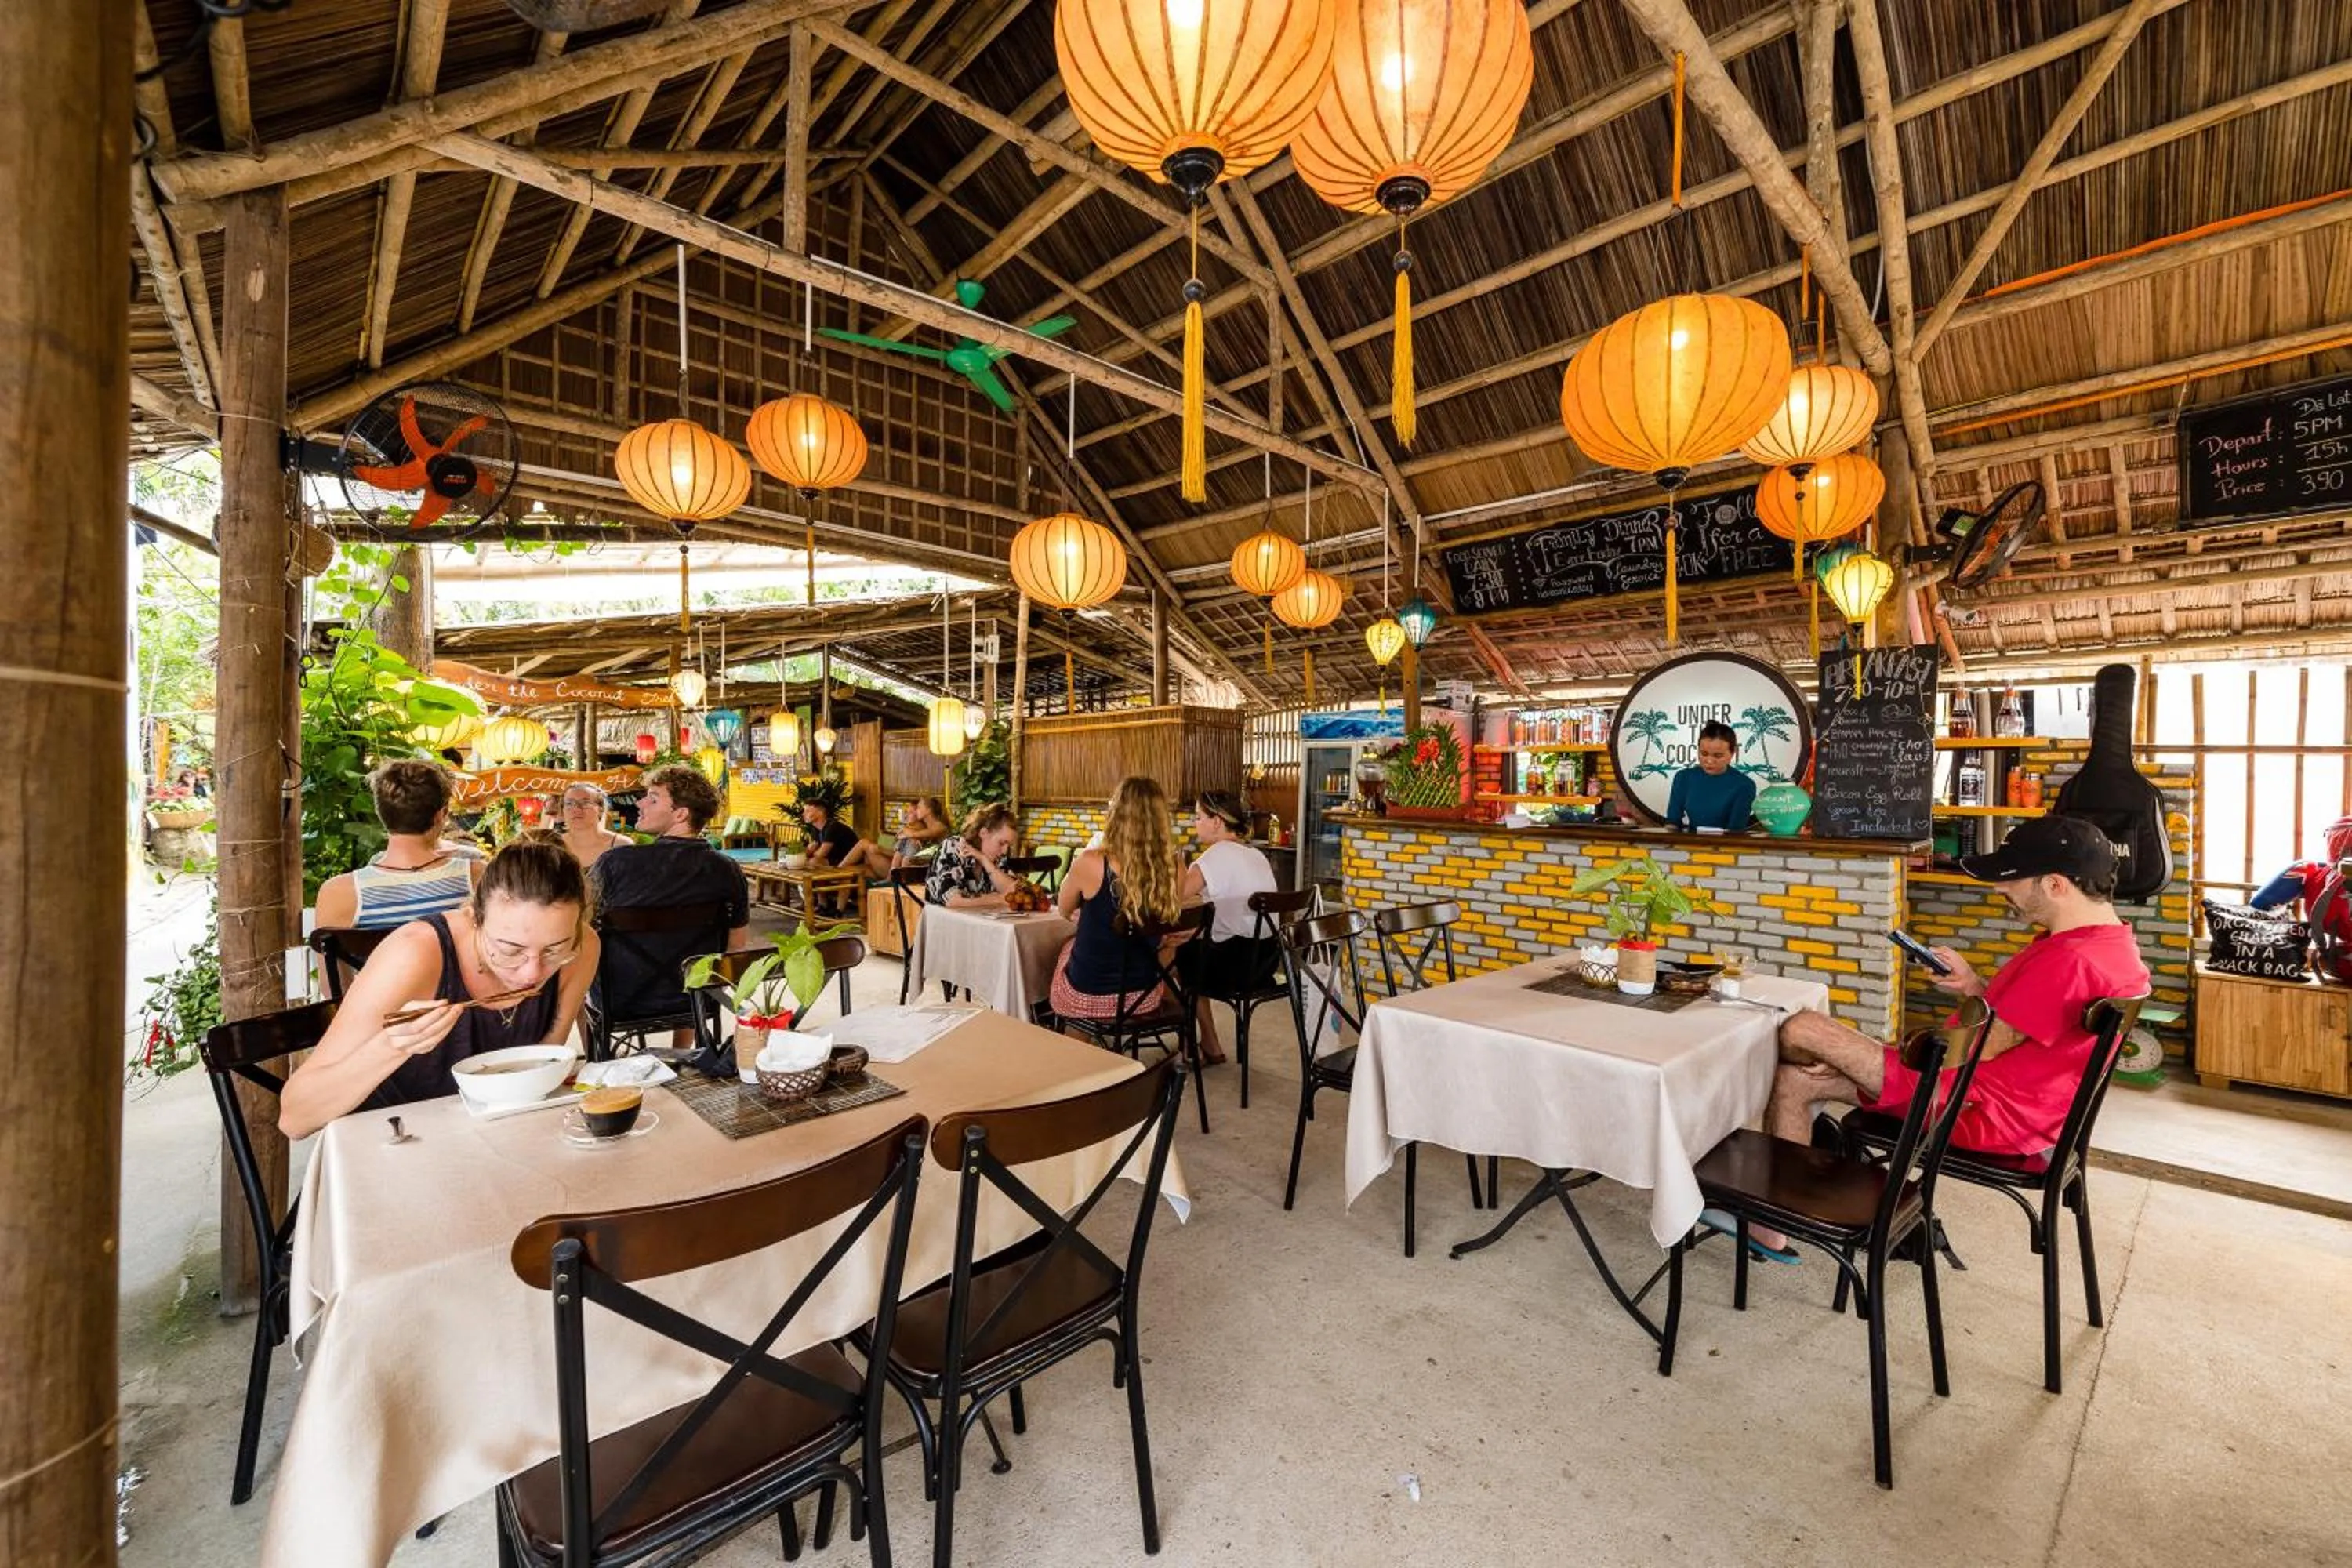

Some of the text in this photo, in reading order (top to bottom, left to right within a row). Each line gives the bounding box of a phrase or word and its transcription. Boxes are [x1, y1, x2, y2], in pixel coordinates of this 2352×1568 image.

[2294, 416, 2343, 440] 5PM
[2211, 456, 2269, 478] Hours
[2304, 441, 2348, 462] 15h
[2214, 479, 2266, 501] Price
[2300, 470, 2344, 495] 390
[1709, 528, 1764, 561] for a
[1719, 546, 1775, 573] FREE
[1824, 650, 1933, 688] BRAKFAST
[508, 684, 539, 698] the
[556, 681, 626, 702] Coconut
[1677, 703, 1732, 724] UNDER
[2235, 944, 2274, 959] IN A
[2263, 962, 2299, 978] BAG
